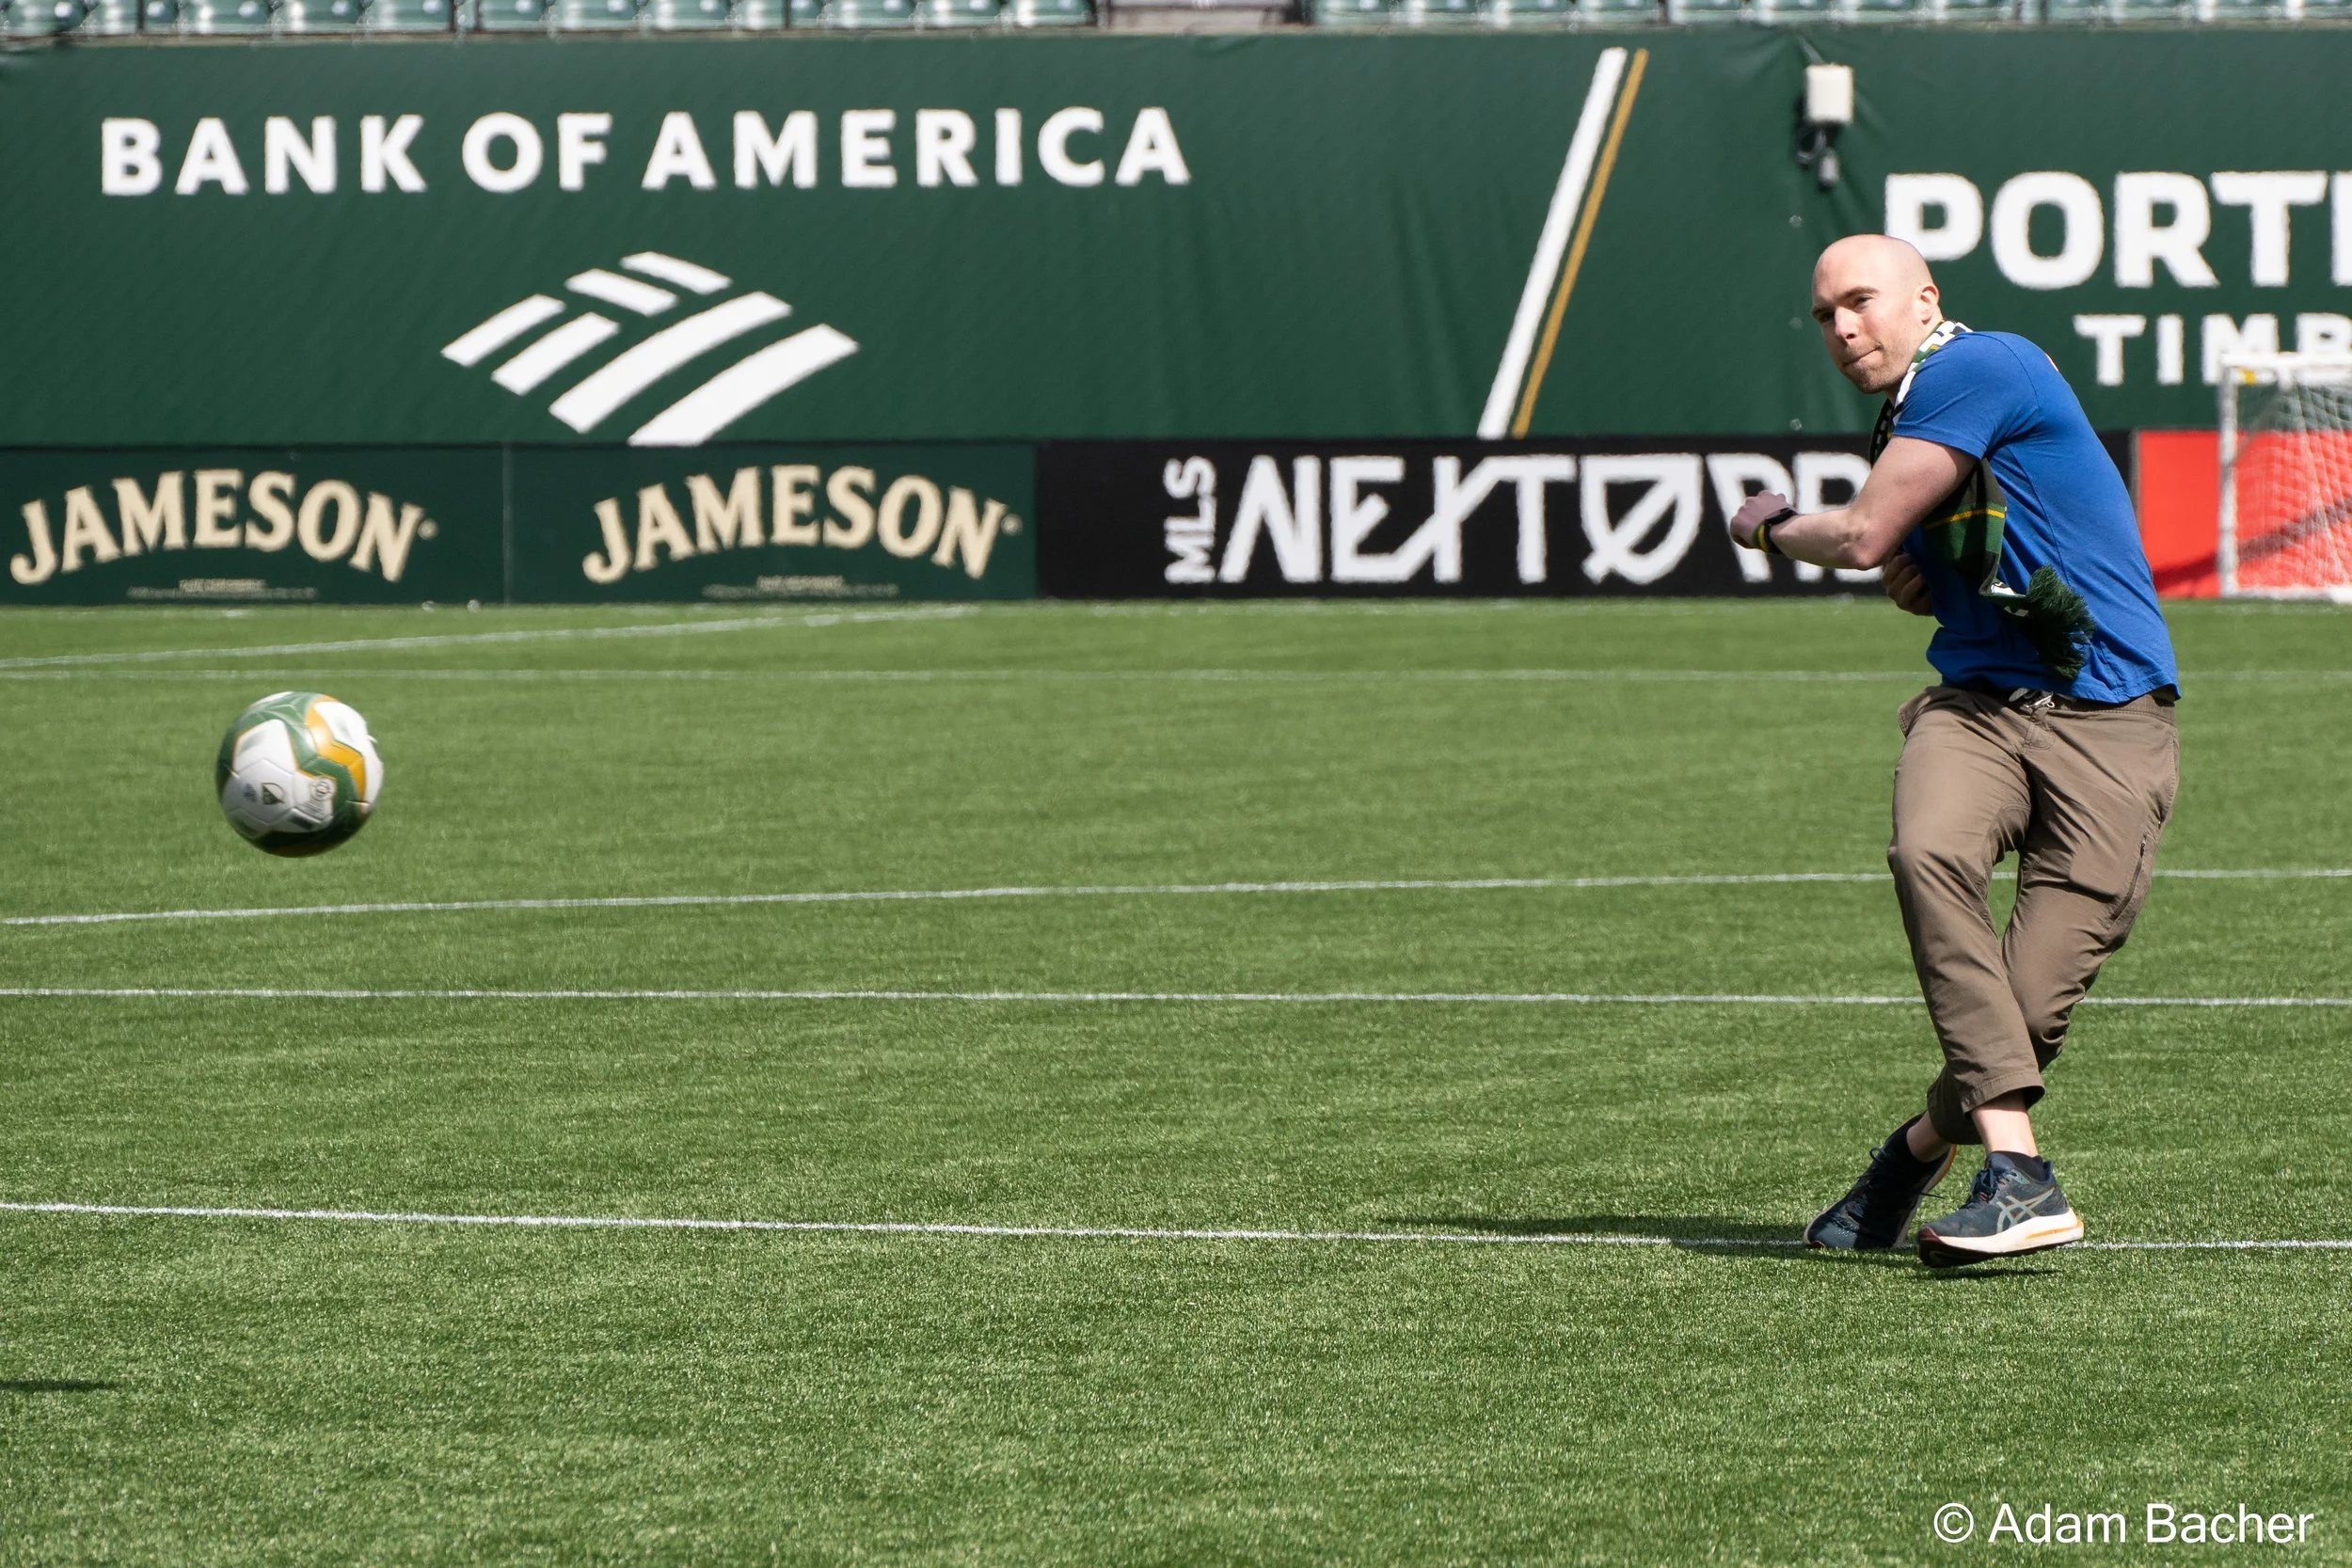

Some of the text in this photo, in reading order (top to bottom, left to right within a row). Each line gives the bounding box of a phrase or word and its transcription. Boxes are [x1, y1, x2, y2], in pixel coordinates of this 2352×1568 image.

[101, 106, 1190, 196] BANK OF AMERICA
[10, 468, 424, 585] JAMESON
[582, 465, 1006, 583] JAMESON
[1164, 456, 1216, 583] MLS
